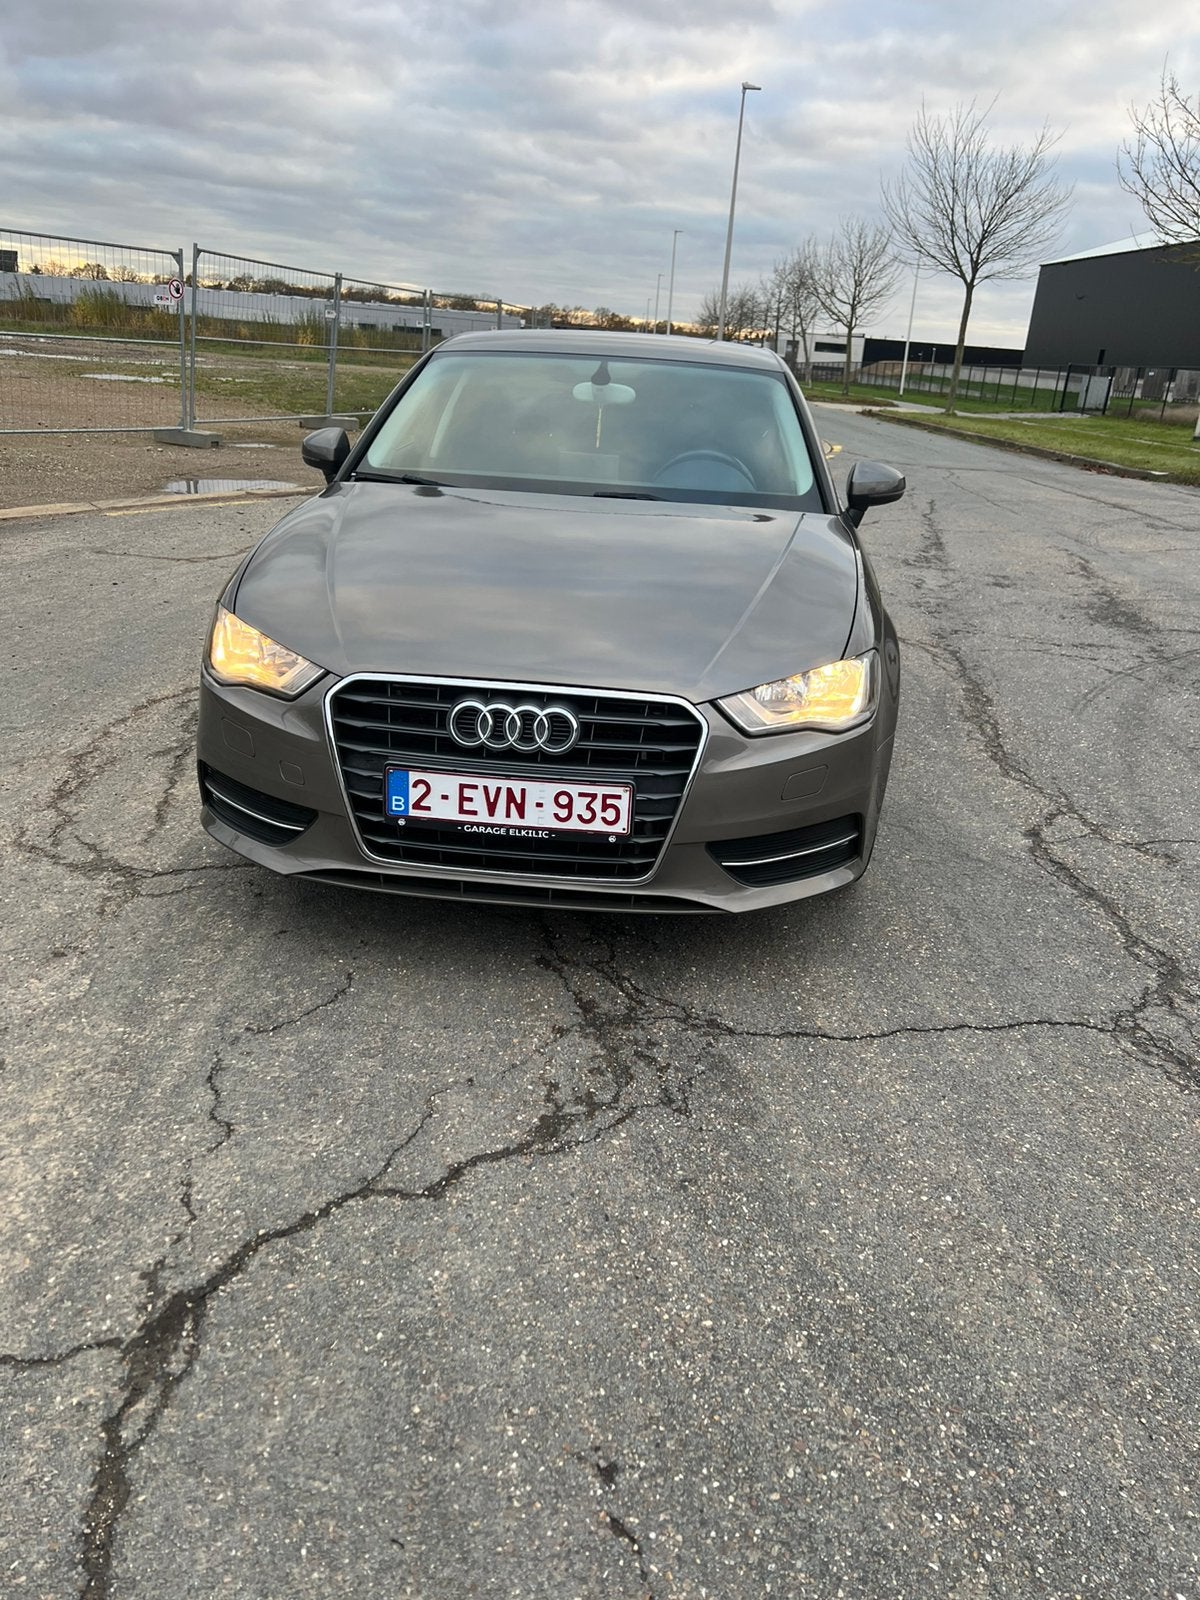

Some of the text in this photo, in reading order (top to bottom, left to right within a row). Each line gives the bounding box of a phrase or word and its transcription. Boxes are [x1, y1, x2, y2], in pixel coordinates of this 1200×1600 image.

[391, 778, 622, 826] B 2-EVN-935
[463, 824, 507, 836] GARAGE
[509, 828, 549, 839] ELKILIC
